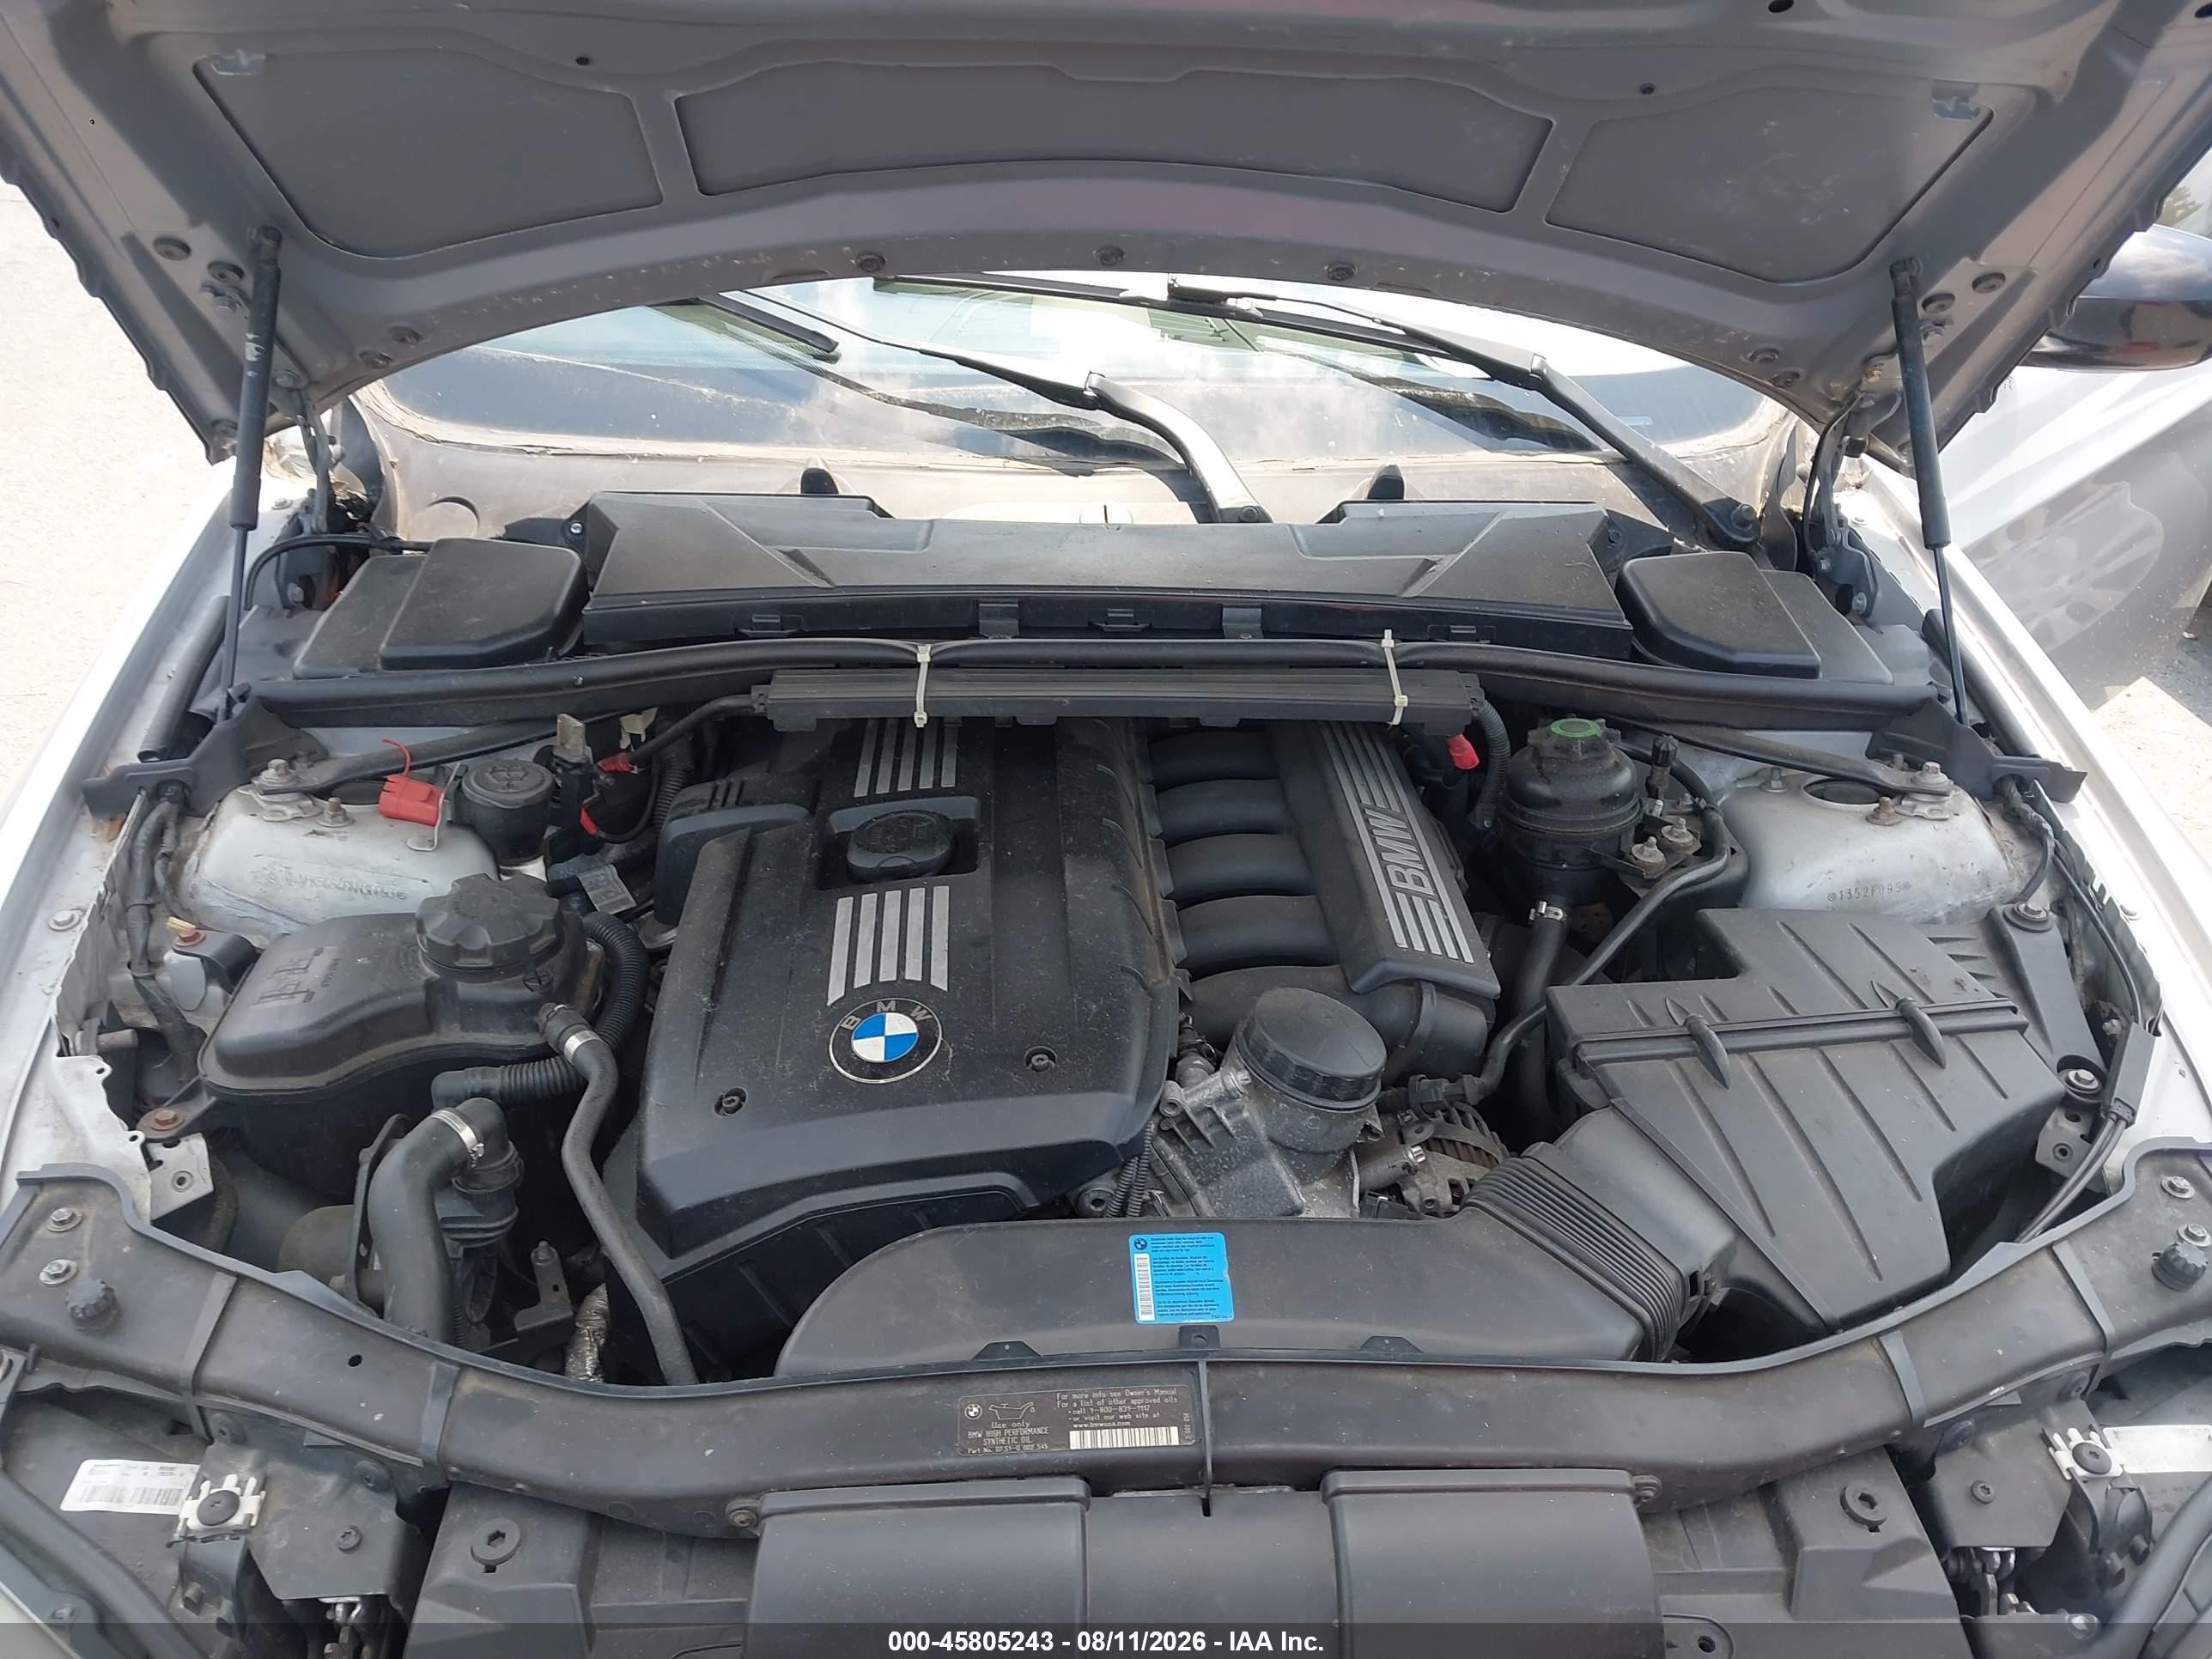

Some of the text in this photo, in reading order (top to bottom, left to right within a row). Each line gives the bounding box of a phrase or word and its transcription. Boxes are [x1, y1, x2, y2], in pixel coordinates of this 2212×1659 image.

[1364, 808, 1436, 896] BMW
[840, 1000, 933, 1030] BMW
[1130, 1396, 1161, 1405] approved
[1012, 1419, 1030, 1429] only
[968, 1426, 1049, 1439] BMW HIGH PERFORMANCE
[983, 1436, 1018, 1446] SYNTHETIC
